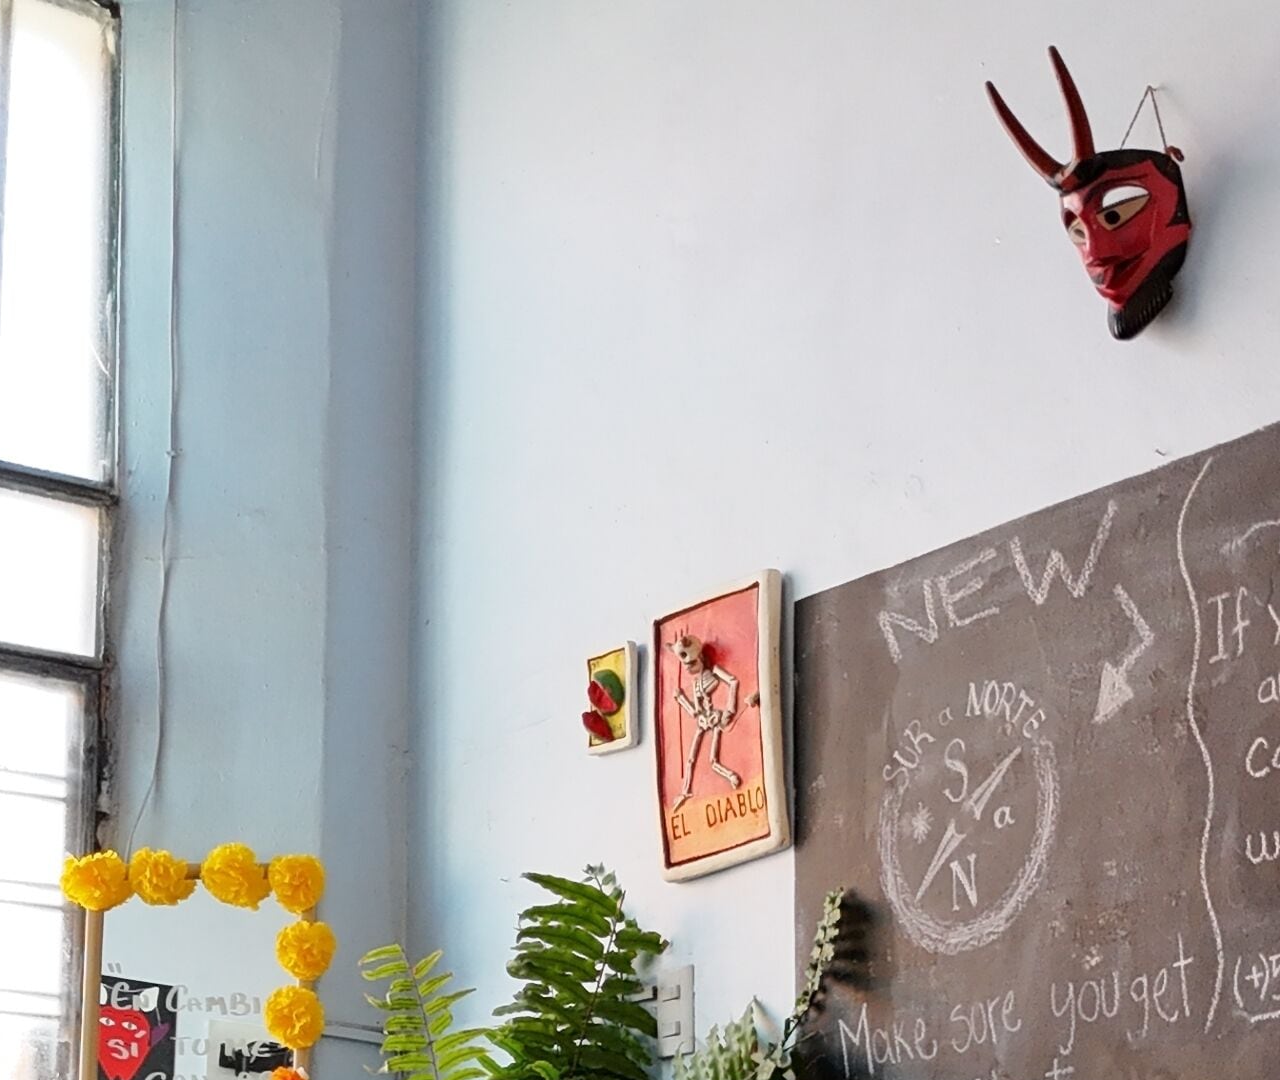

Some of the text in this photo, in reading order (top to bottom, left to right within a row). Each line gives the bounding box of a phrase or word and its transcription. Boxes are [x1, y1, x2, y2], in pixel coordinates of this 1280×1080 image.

[877, 500, 1117, 663] NEW
[1208, 588, 1251, 664] If
[882, 719, 936, 796] SUR
[965, 680, 1046, 739] NORTE
[671, 786, 765, 841] EL DIABLO
[166, 984, 261, 1016] CAMBI
[838, 1002, 937, 1079] Make
[1127, 933, 1194, 1040] get
